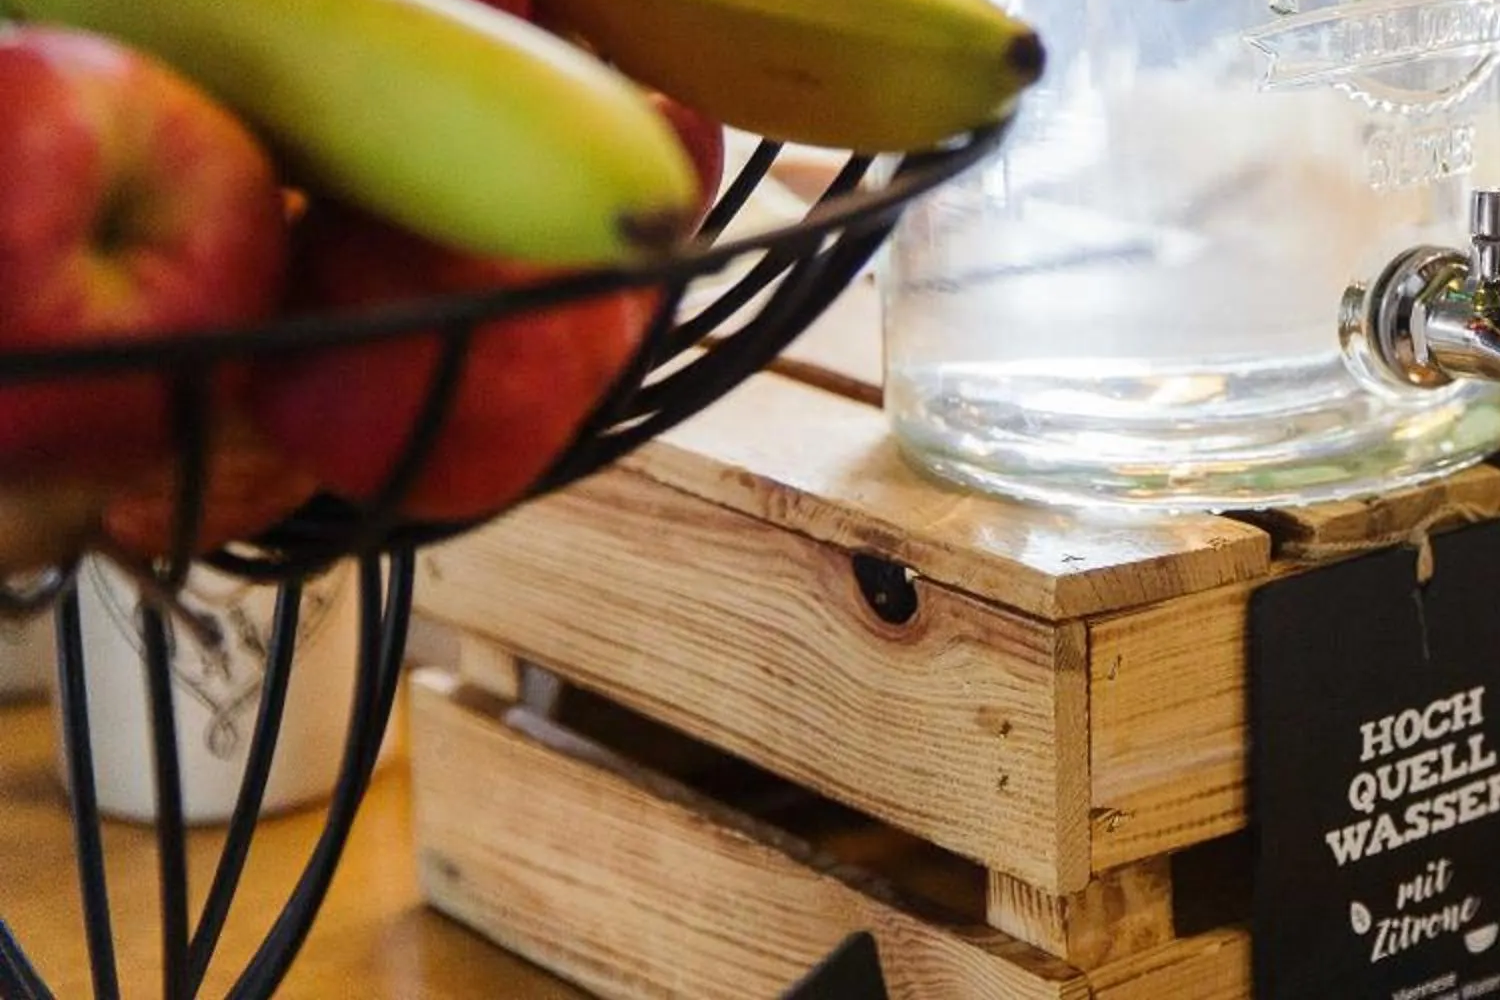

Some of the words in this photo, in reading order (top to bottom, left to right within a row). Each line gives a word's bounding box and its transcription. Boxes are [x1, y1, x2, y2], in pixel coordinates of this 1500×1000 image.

[1359, 685, 1485, 762] HOCH
[1348, 732, 1497, 814] QUELL
[1396, 857, 1453, 911] mit
[1369, 896, 1480, 964] Zitrone
